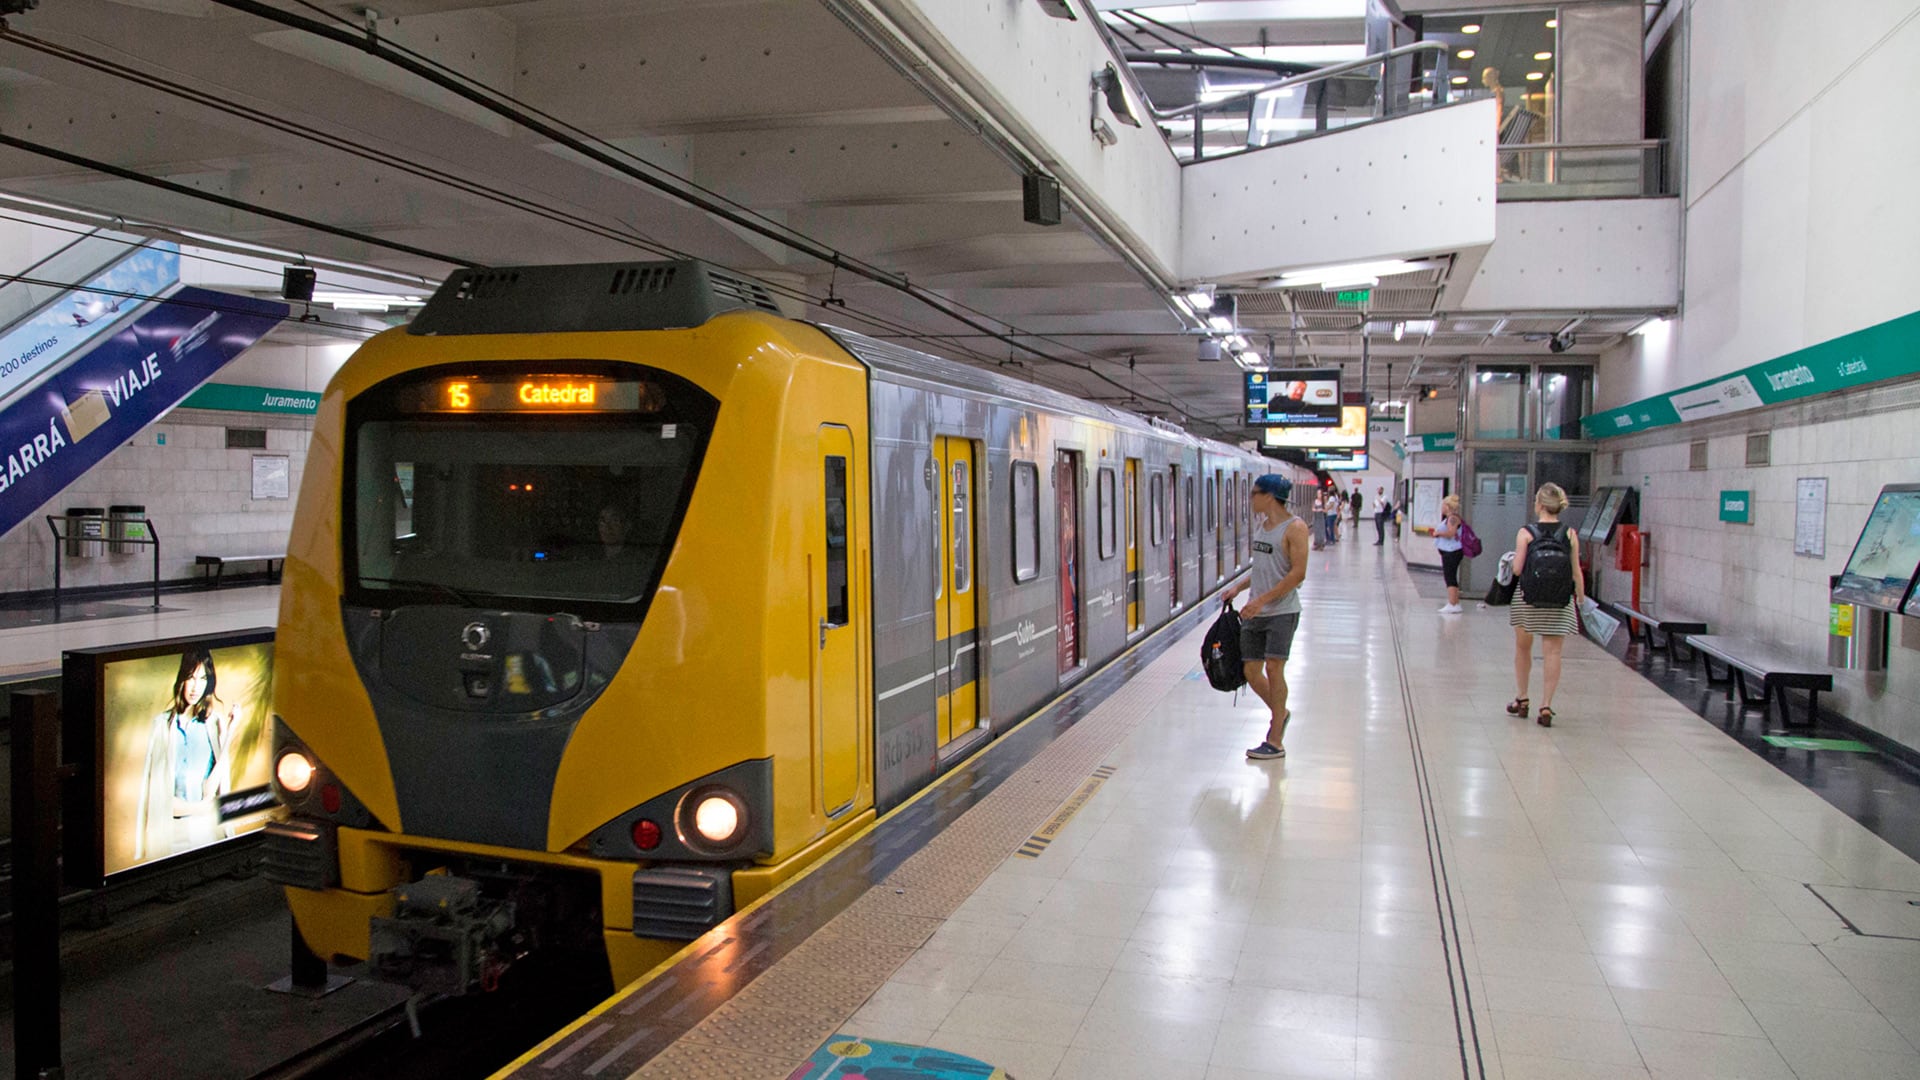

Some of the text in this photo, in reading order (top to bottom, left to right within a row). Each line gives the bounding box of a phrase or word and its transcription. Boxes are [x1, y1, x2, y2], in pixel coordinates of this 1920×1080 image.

[0, 336, 58, 378] 200 destinos
[107, 352, 162, 407] VIAJE
[1763, 363, 1815, 392] Juramento
[262, 393, 317, 410] Juramento
[448, 383, 595, 408] 15 Catedral
[1015, 619, 1035, 646] Subte
